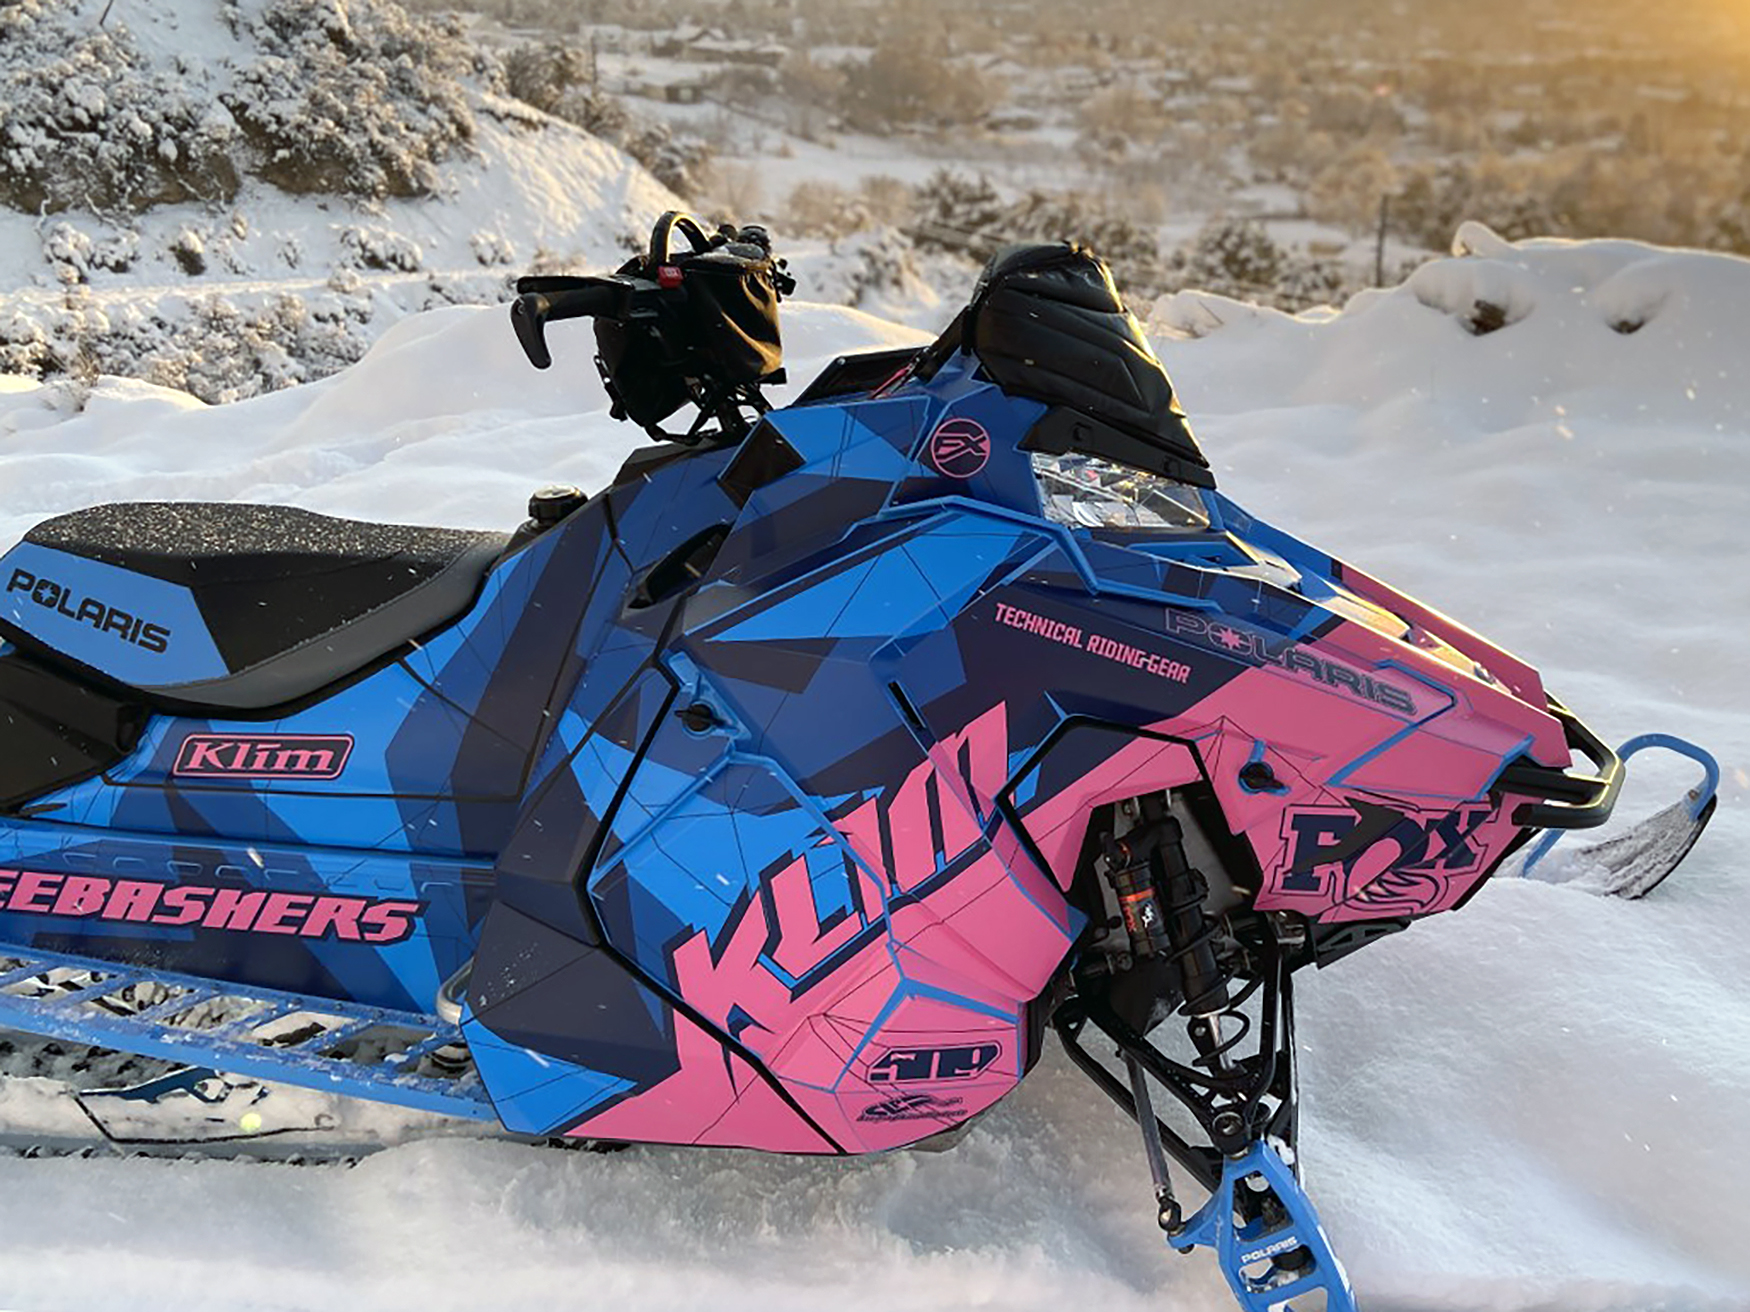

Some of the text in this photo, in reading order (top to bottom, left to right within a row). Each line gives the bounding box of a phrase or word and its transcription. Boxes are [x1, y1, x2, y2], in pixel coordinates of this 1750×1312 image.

[7, 568, 170, 654] POLARIS
[995, 603, 1082, 649] TECHNICAL
[1147, 653, 1191, 684] GEAR
[1165, 608, 1418, 716] POLARIS
[185, 741, 336, 772] Klim
[1241, 1236, 1298, 1263] POLARIS
